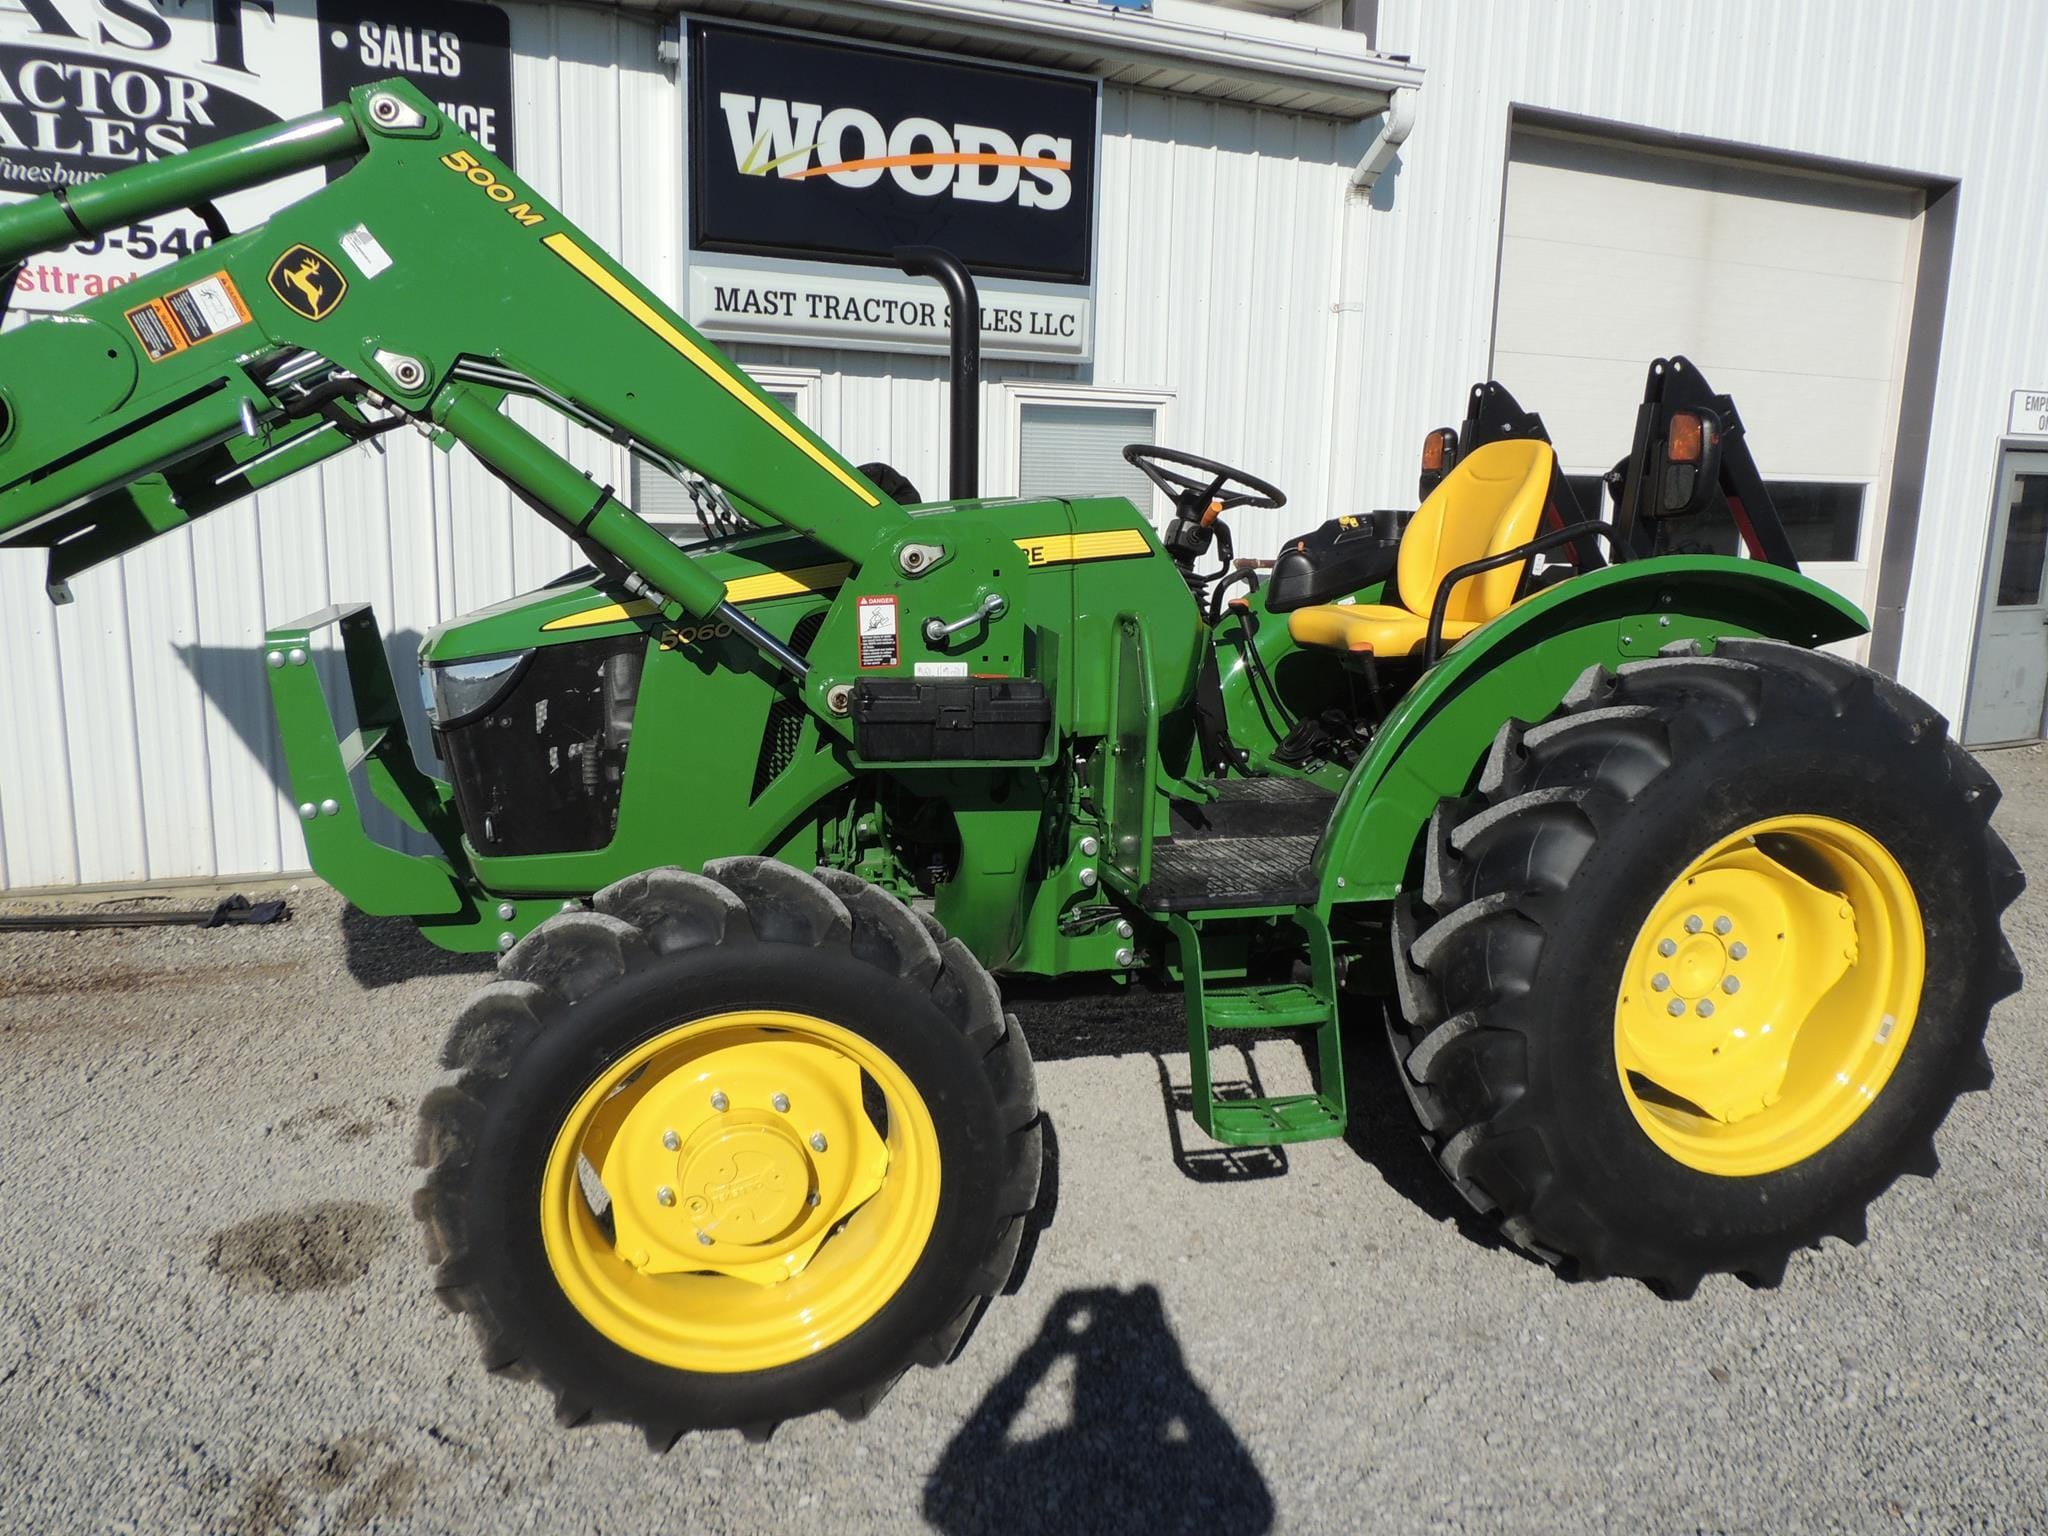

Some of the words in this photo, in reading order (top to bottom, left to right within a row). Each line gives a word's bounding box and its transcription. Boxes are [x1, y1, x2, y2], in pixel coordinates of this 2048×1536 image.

[358, 21, 461, 77] SALES
[720, 92, 1072, 210] WOODS
[714, 286, 797, 316] MAST
[806, 293, 936, 327] TRACTOR
[944, 304, 1022, 333] SLES
[1029, 311, 1075, 337] LLC
